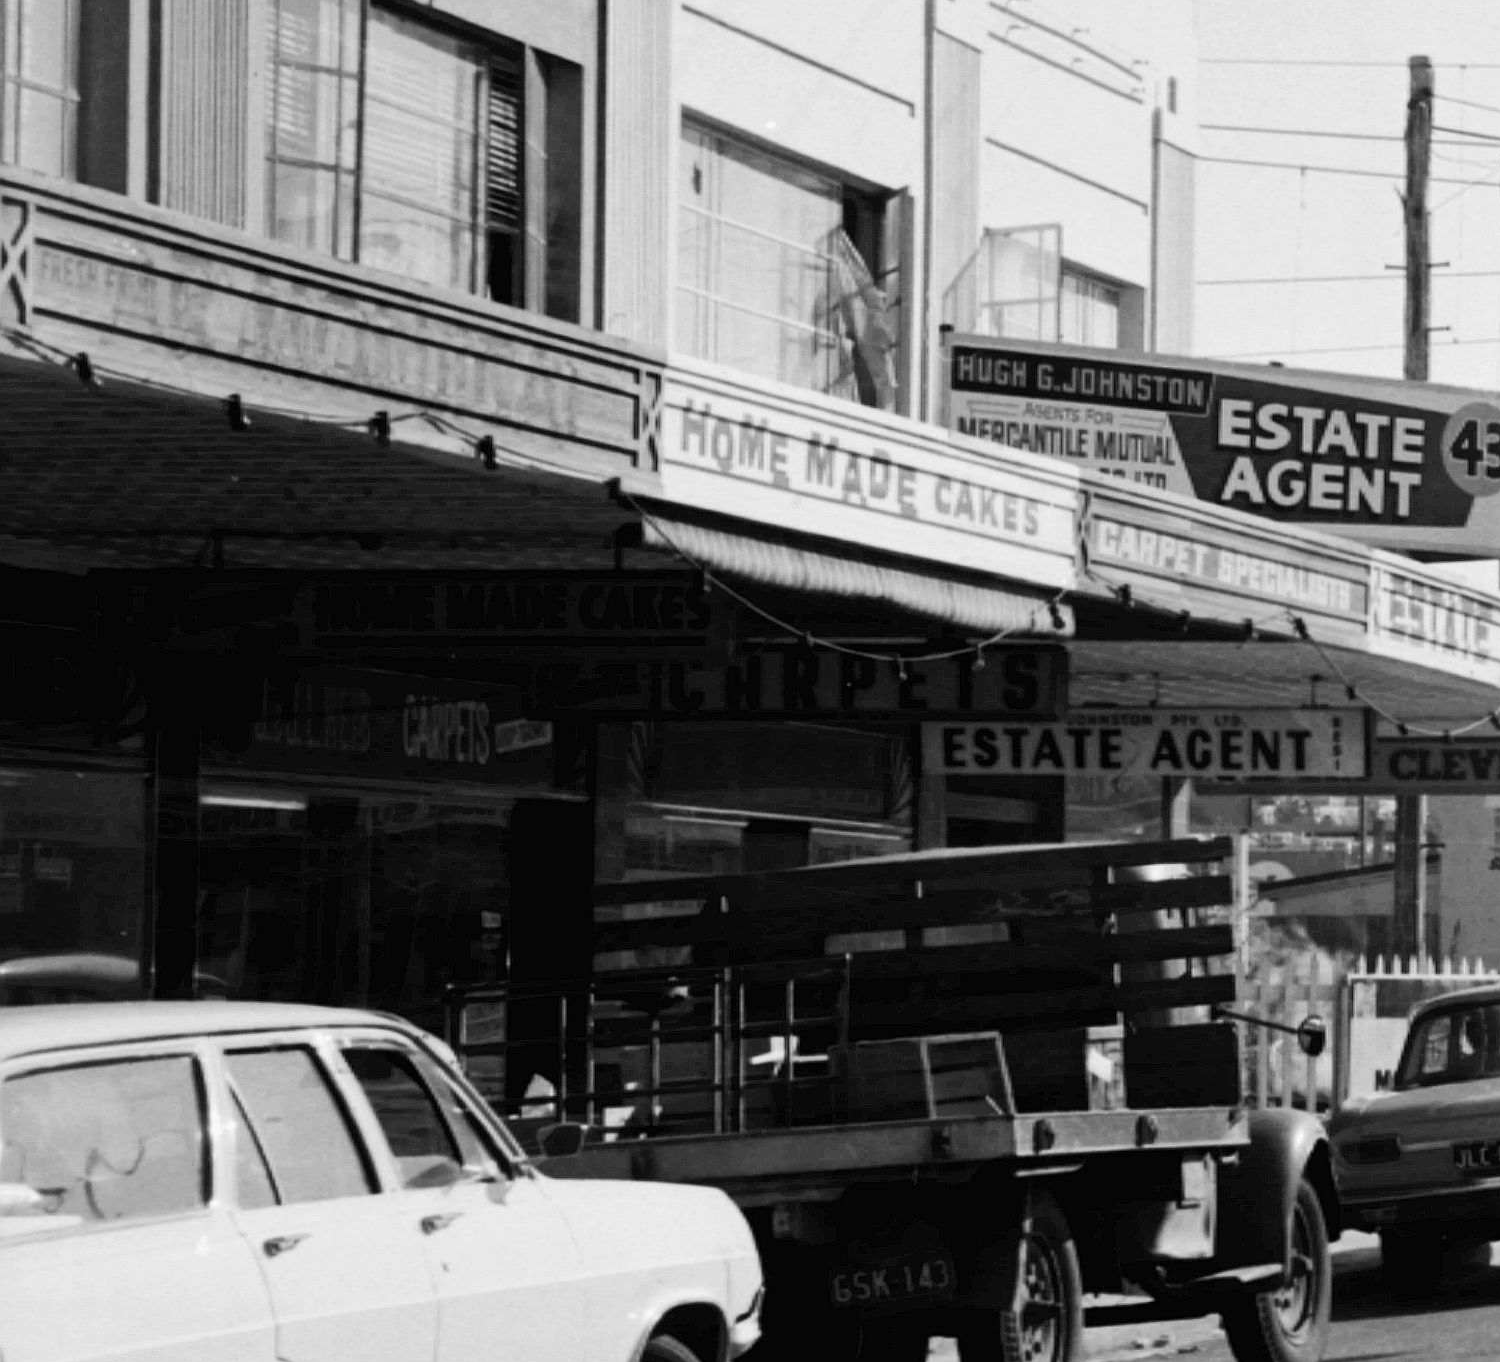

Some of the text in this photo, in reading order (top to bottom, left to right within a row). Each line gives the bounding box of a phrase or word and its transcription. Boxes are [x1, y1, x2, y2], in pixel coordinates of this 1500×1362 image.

[958, 351, 1027, 388] HUGH
[957, 416, 1176, 466] MERCANTILE MUTUAL
[1084, 407, 1113, 425] FOR
[1216, 397, 1426, 466] ESTATE
[682, 399, 1039, 536] HOME MADE CAKES
[1220, 454, 1423, 519] AGENT
[1101, 518, 1207, 579] CARPET
[579, 582, 712, 632] CAKES
[403, 693, 490, 765] CARPETS
[943, 727, 1314, 772] ESTATE AGENT
